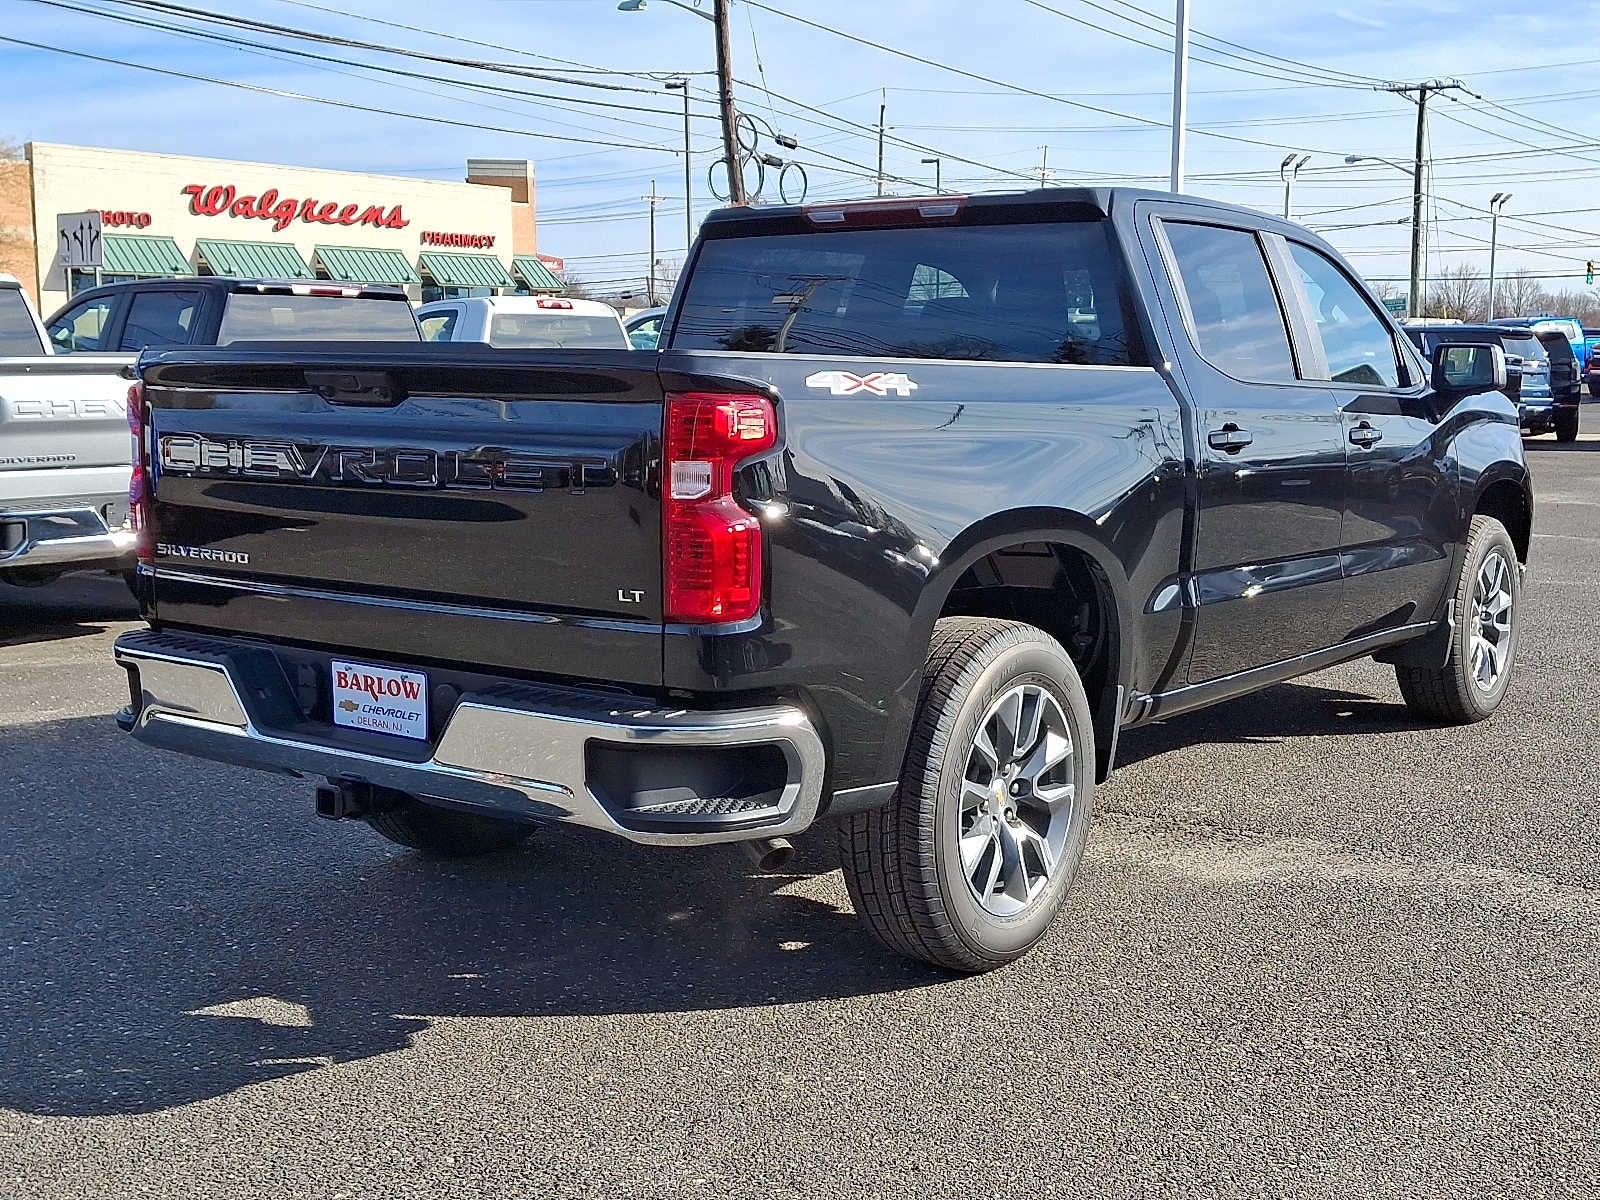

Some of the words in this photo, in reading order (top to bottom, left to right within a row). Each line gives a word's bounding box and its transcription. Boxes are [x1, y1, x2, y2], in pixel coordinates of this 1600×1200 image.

[181, 184, 410, 232] Walgreens
[88, 209, 152, 228] HOTO
[421, 231, 496, 249] PHARMACY
[160, 432, 610, 496] CHEVROLET
[155, 542, 250, 565] SILVERADO
[617, 588, 645, 603] LT
[335, 670, 422, 702] BARLOW
[361, 704, 422, 722] CHEVROLET
[392, 723, 403, 732] NJ
